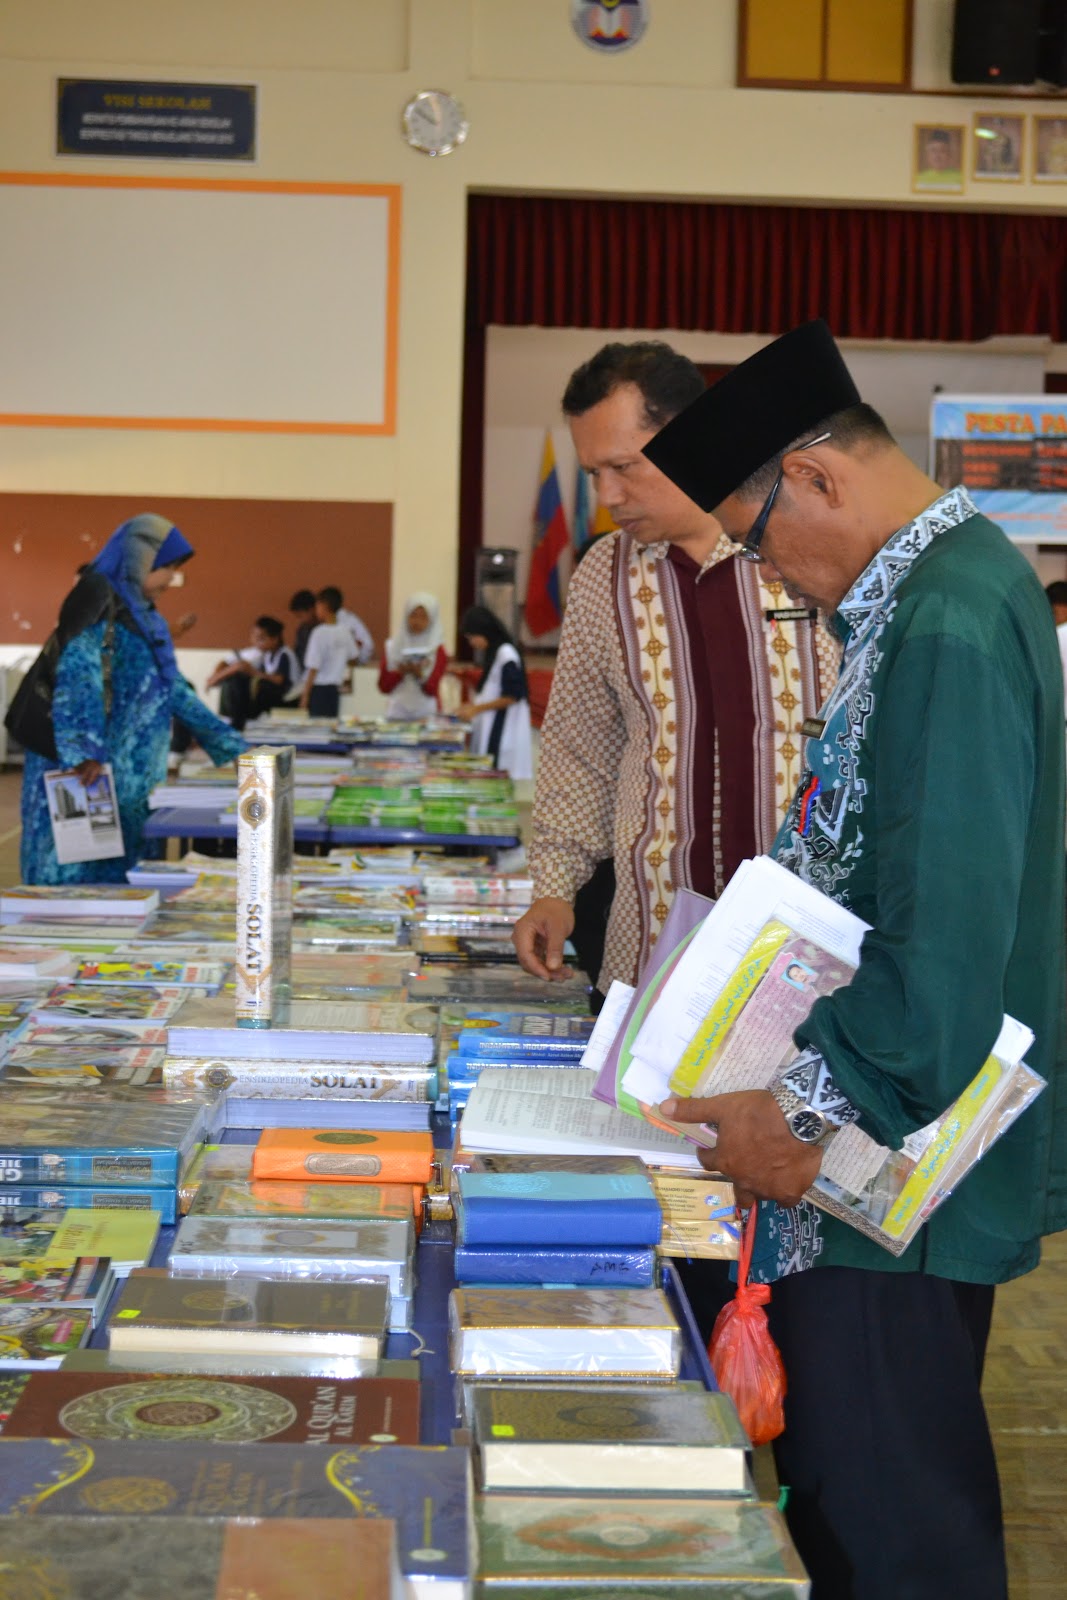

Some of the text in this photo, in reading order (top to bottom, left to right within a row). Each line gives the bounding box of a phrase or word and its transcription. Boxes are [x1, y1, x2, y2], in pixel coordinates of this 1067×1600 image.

[965, 412, 1036, 433] PESTA
[246, 903, 262, 974] SOLAT
[239, 1074, 379, 1089] ENSIKLOPEDIA SOLAT
[307, 1386, 338, 1430] QUR'AN
[334, 1395, 357, 1438] AL KARIM
